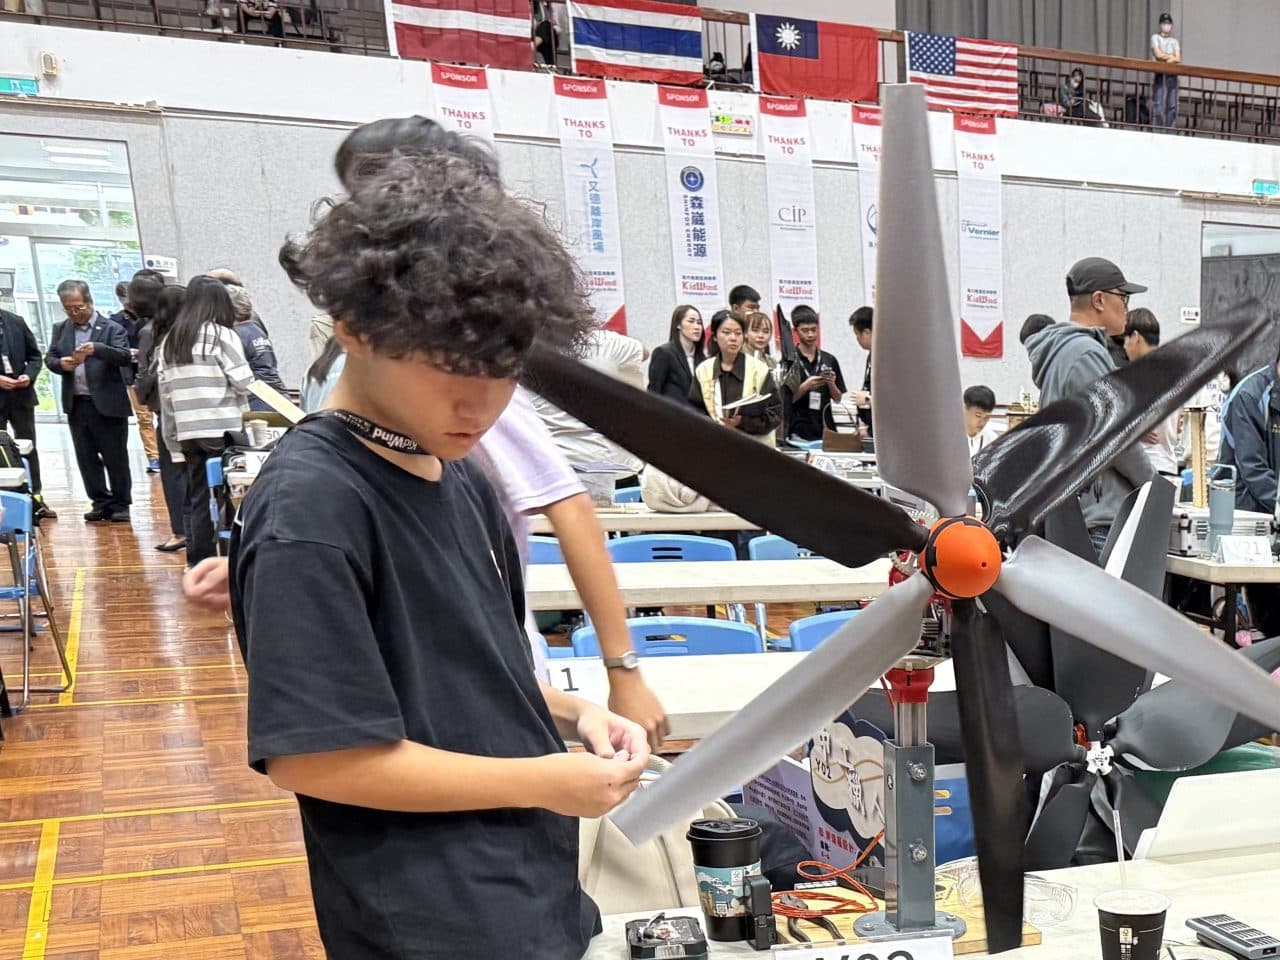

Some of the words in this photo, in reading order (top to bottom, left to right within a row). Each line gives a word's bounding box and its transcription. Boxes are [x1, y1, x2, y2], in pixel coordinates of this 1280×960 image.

[440, 72, 477, 83] SPONSOR
[562, 83, 598, 94] SPONSOR
[666, 93, 699, 102] SPONSOR
[766, 102, 798, 112] SPONSOR
[441, 107, 486, 120] THANKS
[456, 119, 472, 129] TO
[563, 118, 606, 129] THANKS
[960, 119, 989, 129] SPONSOR
[578, 129, 593, 138] TO
[667, 126, 708, 138] THANKS
[681, 138, 696, 147] TO
[768, 135, 806, 146] THANKS
[781, 146, 794, 155] TO
[960, 150, 995, 162] THANKS
[973, 161, 984, 170] TO
[815, 757, 832, 780] Y02
